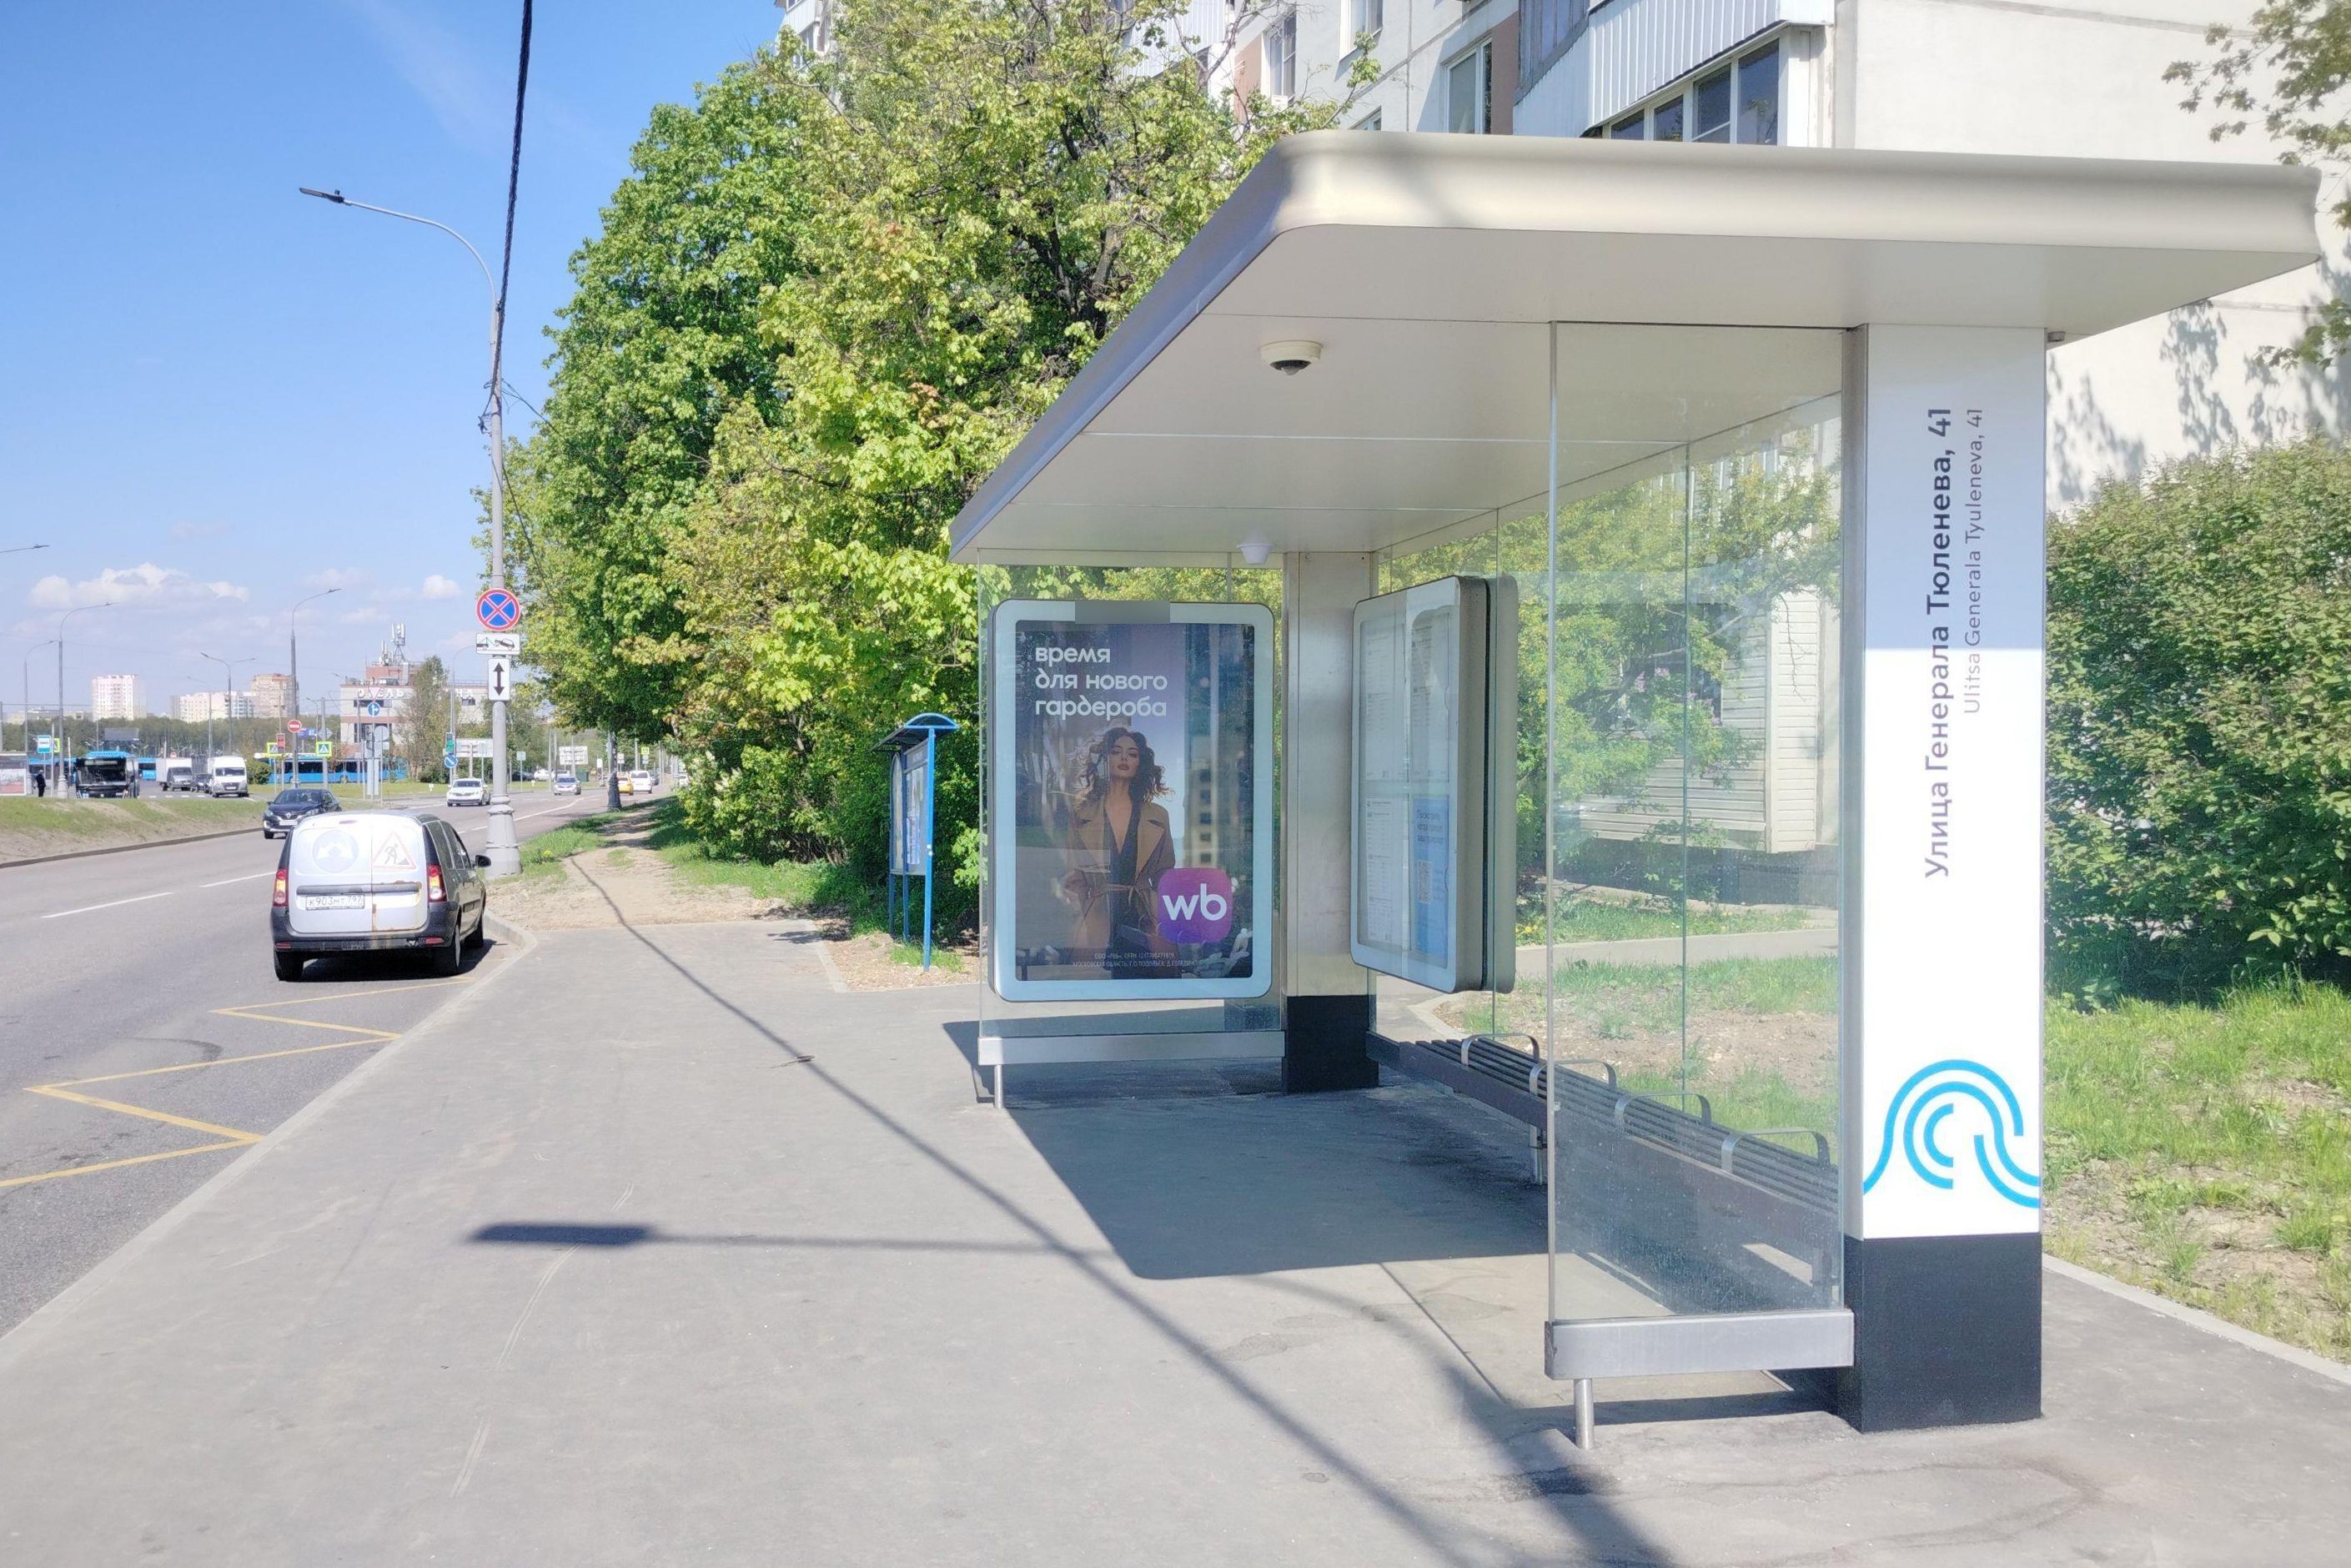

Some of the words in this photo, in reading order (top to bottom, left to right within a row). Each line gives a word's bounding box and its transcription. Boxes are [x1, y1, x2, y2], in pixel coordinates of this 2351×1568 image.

[1928, 409, 1952, 437] 41
[1967, 409, 1983, 428] 41
[1965, 435, 1985, 545] Tyuleneva,
[1927, 449, 1956, 616] Тюленева,
[1964, 550, 1982, 646] Generala
[1035, 647, 1111, 667] время
[358, 687, 405, 699] ОЕЛЬ
[1035, 667, 1078, 689] для
[1086, 674, 1168, 691] нового
[1925, 626, 1954, 771] Генерала
[1963, 653, 1981, 713] Ulitsa
[1035, 695, 1167, 721] гардероба
[1925, 782, 1952, 878] Улица
[1162, 882, 1228, 922] wb
